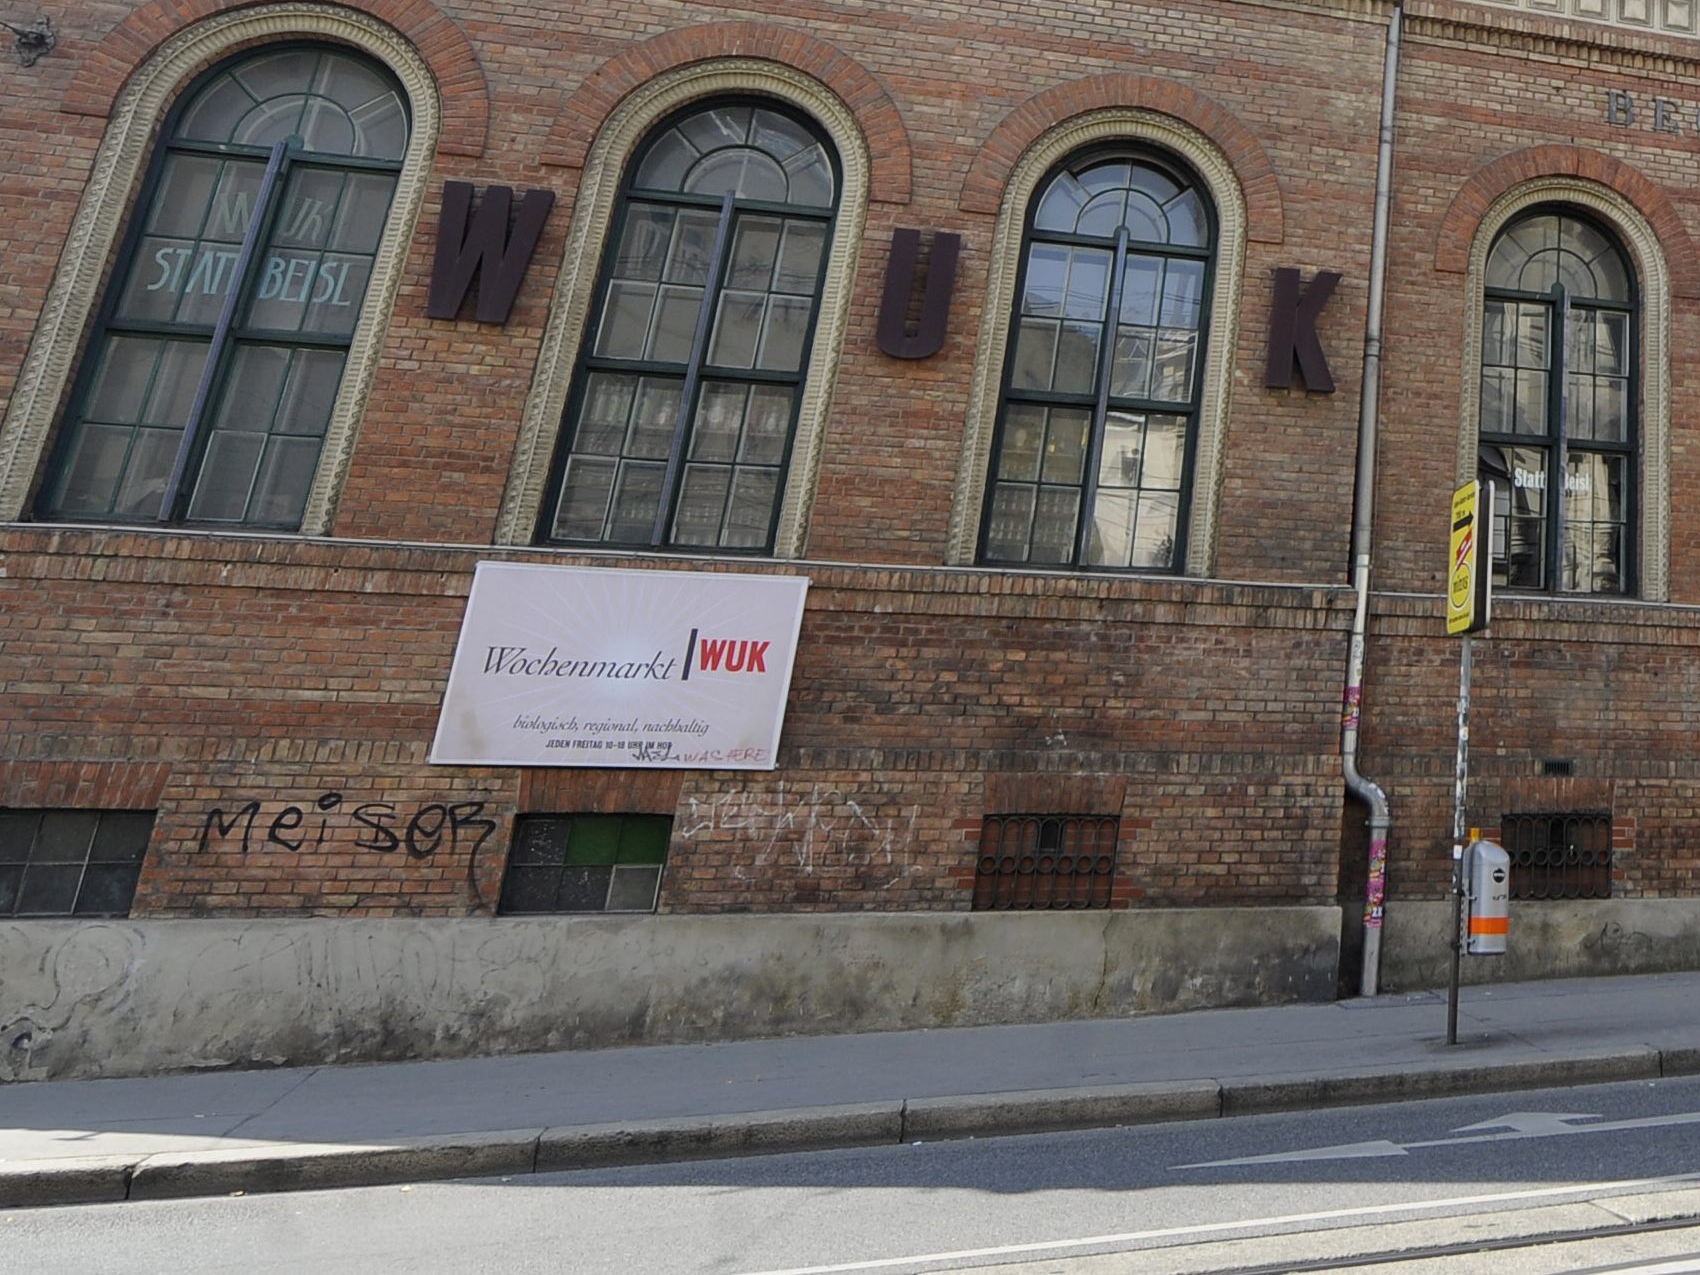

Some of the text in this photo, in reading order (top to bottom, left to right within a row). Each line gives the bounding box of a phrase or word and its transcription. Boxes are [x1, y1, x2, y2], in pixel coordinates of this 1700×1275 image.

[259, 256, 351, 306] BEISL
[428, 181, 1343, 393] W U K
[1515, 467, 1545, 489] Statt
[483, 638, 770, 681] Wochenmarkt WUK
[513, 714, 710, 737] biologisch, regional, nachhaltig
[545, 740, 571, 749] JEDEN
[572, 740, 602, 750] FREITAG
[627, 740, 643, 750] UHR
